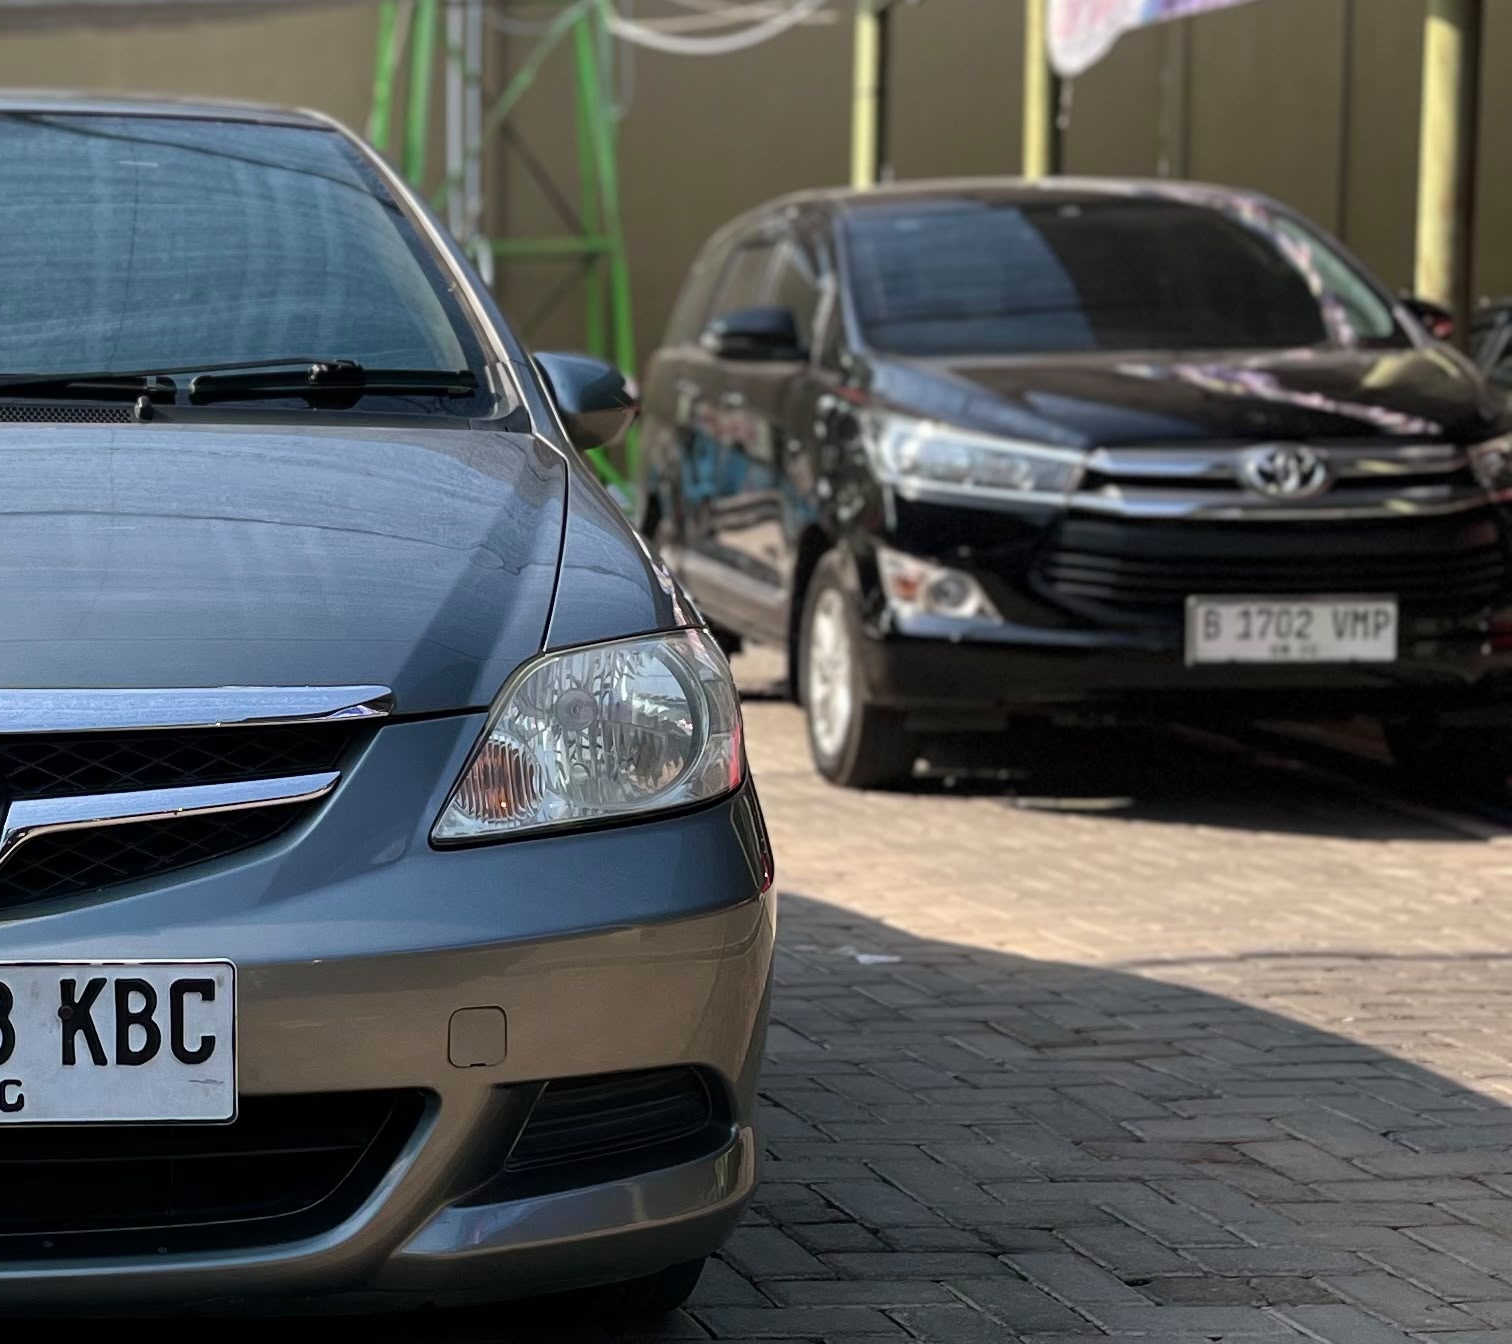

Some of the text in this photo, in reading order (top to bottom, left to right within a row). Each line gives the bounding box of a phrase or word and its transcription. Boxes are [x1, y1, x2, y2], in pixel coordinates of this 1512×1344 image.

[1203, 608, 1391, 641] B 1702 VMP
[59, 978, 216, 1067] KBC
